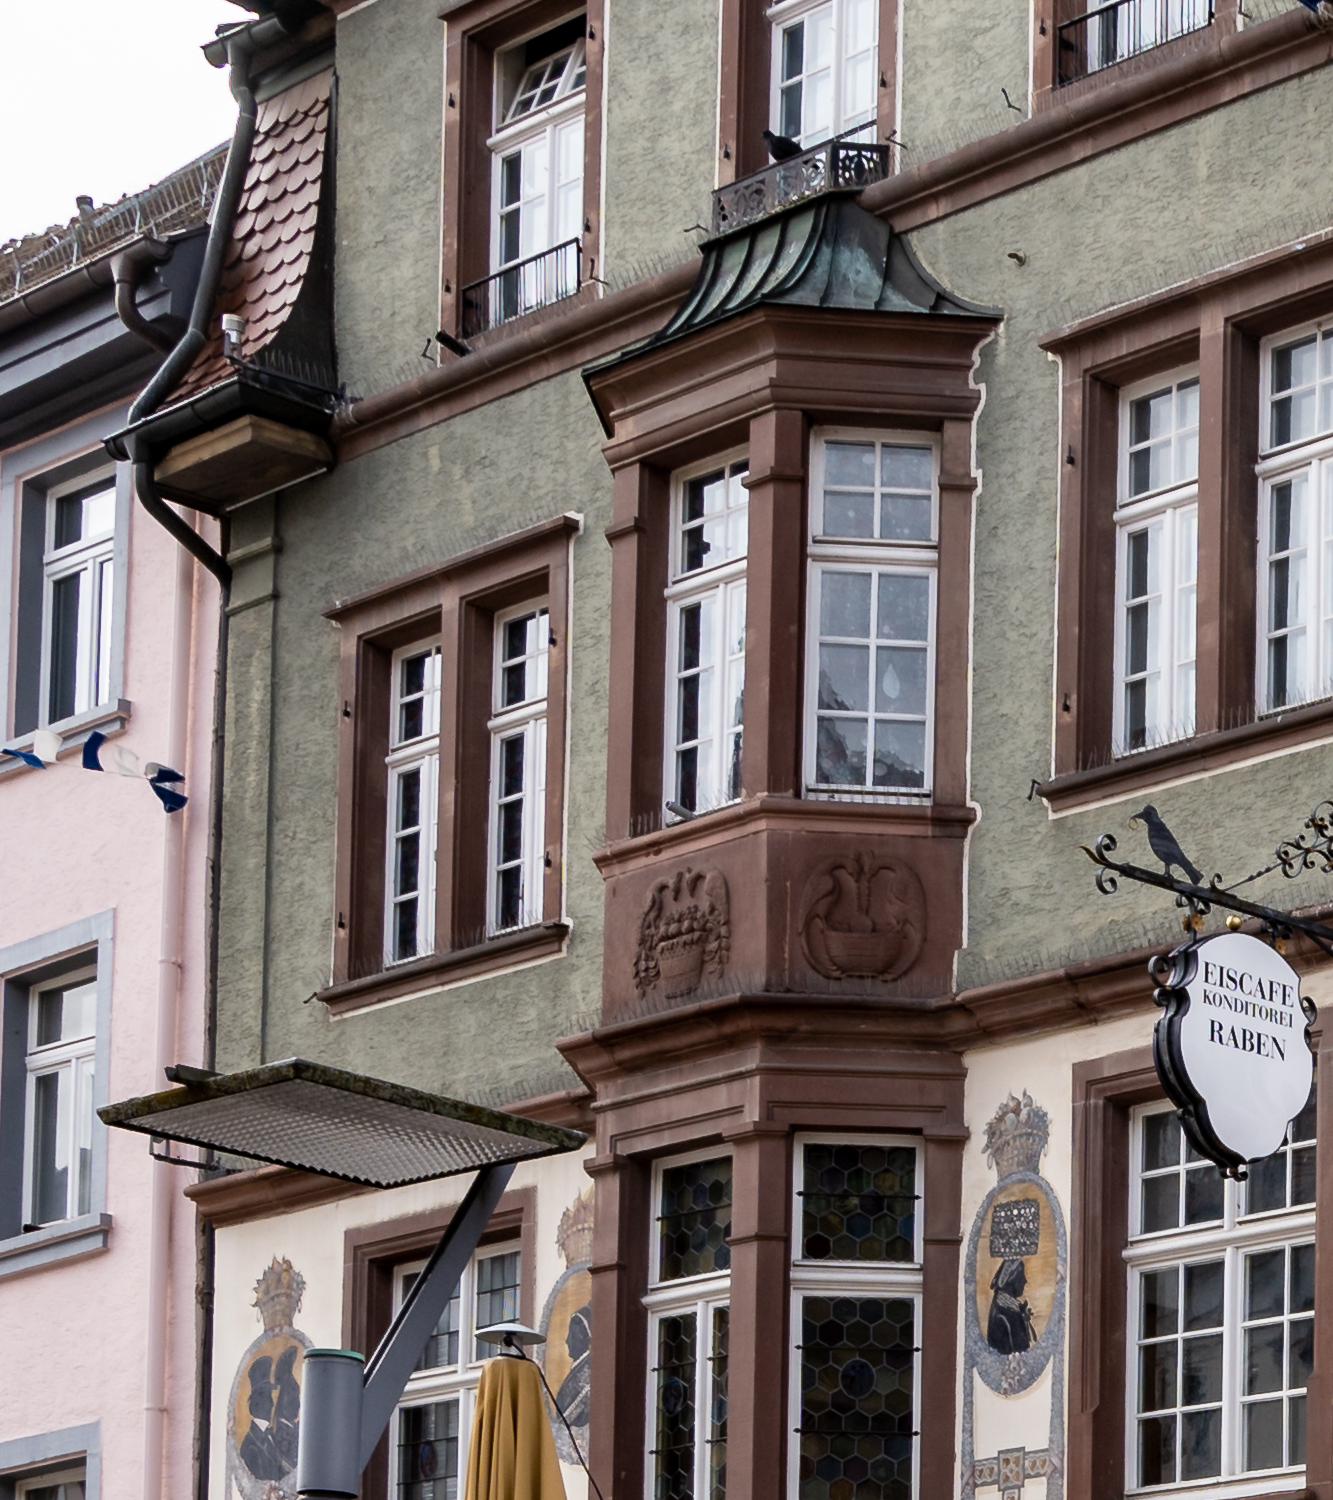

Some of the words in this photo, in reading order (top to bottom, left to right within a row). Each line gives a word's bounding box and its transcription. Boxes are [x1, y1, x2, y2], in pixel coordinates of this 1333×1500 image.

[1203, 960, 1294, 1008] EISCAFE
[1203, 988, 1293, 1028] KONDITOREI
[1209, 1018, 1286, 1062] RABEN
